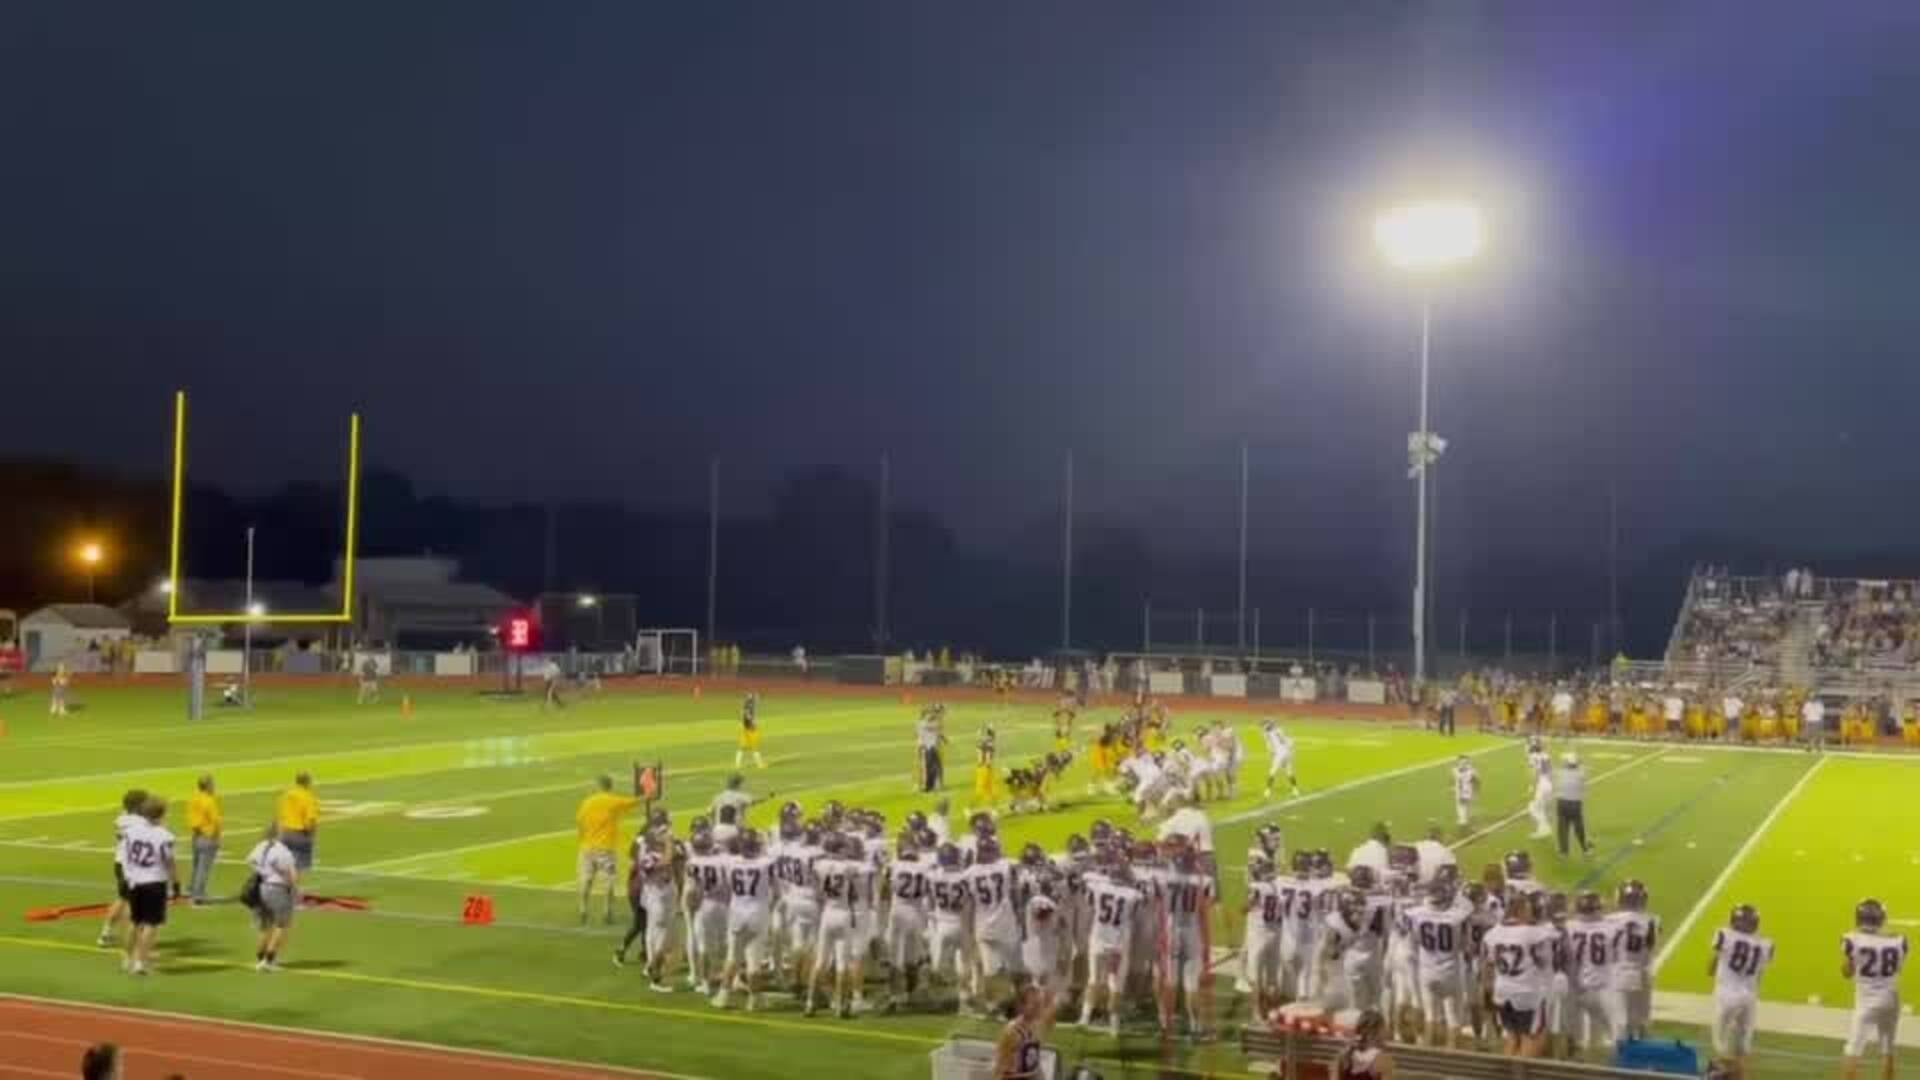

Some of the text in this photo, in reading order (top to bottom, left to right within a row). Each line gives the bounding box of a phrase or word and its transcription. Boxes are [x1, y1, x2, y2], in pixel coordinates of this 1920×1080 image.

[731, 869, 760, 896] 67
[898, 873, 923, 898] 21
[935, 882, 964, 911] 52
[976, 873, 1004, 905] 57
[1100, 893, 1125, 926] 51
[1282, 888, 1312, 919] 73
[1421, 922, 1453, 953] 60
[1573, 932, 1605, 966] 76
[1729, 941, 1762, 976] 81
[1859, 948, 1899, 977] 28
